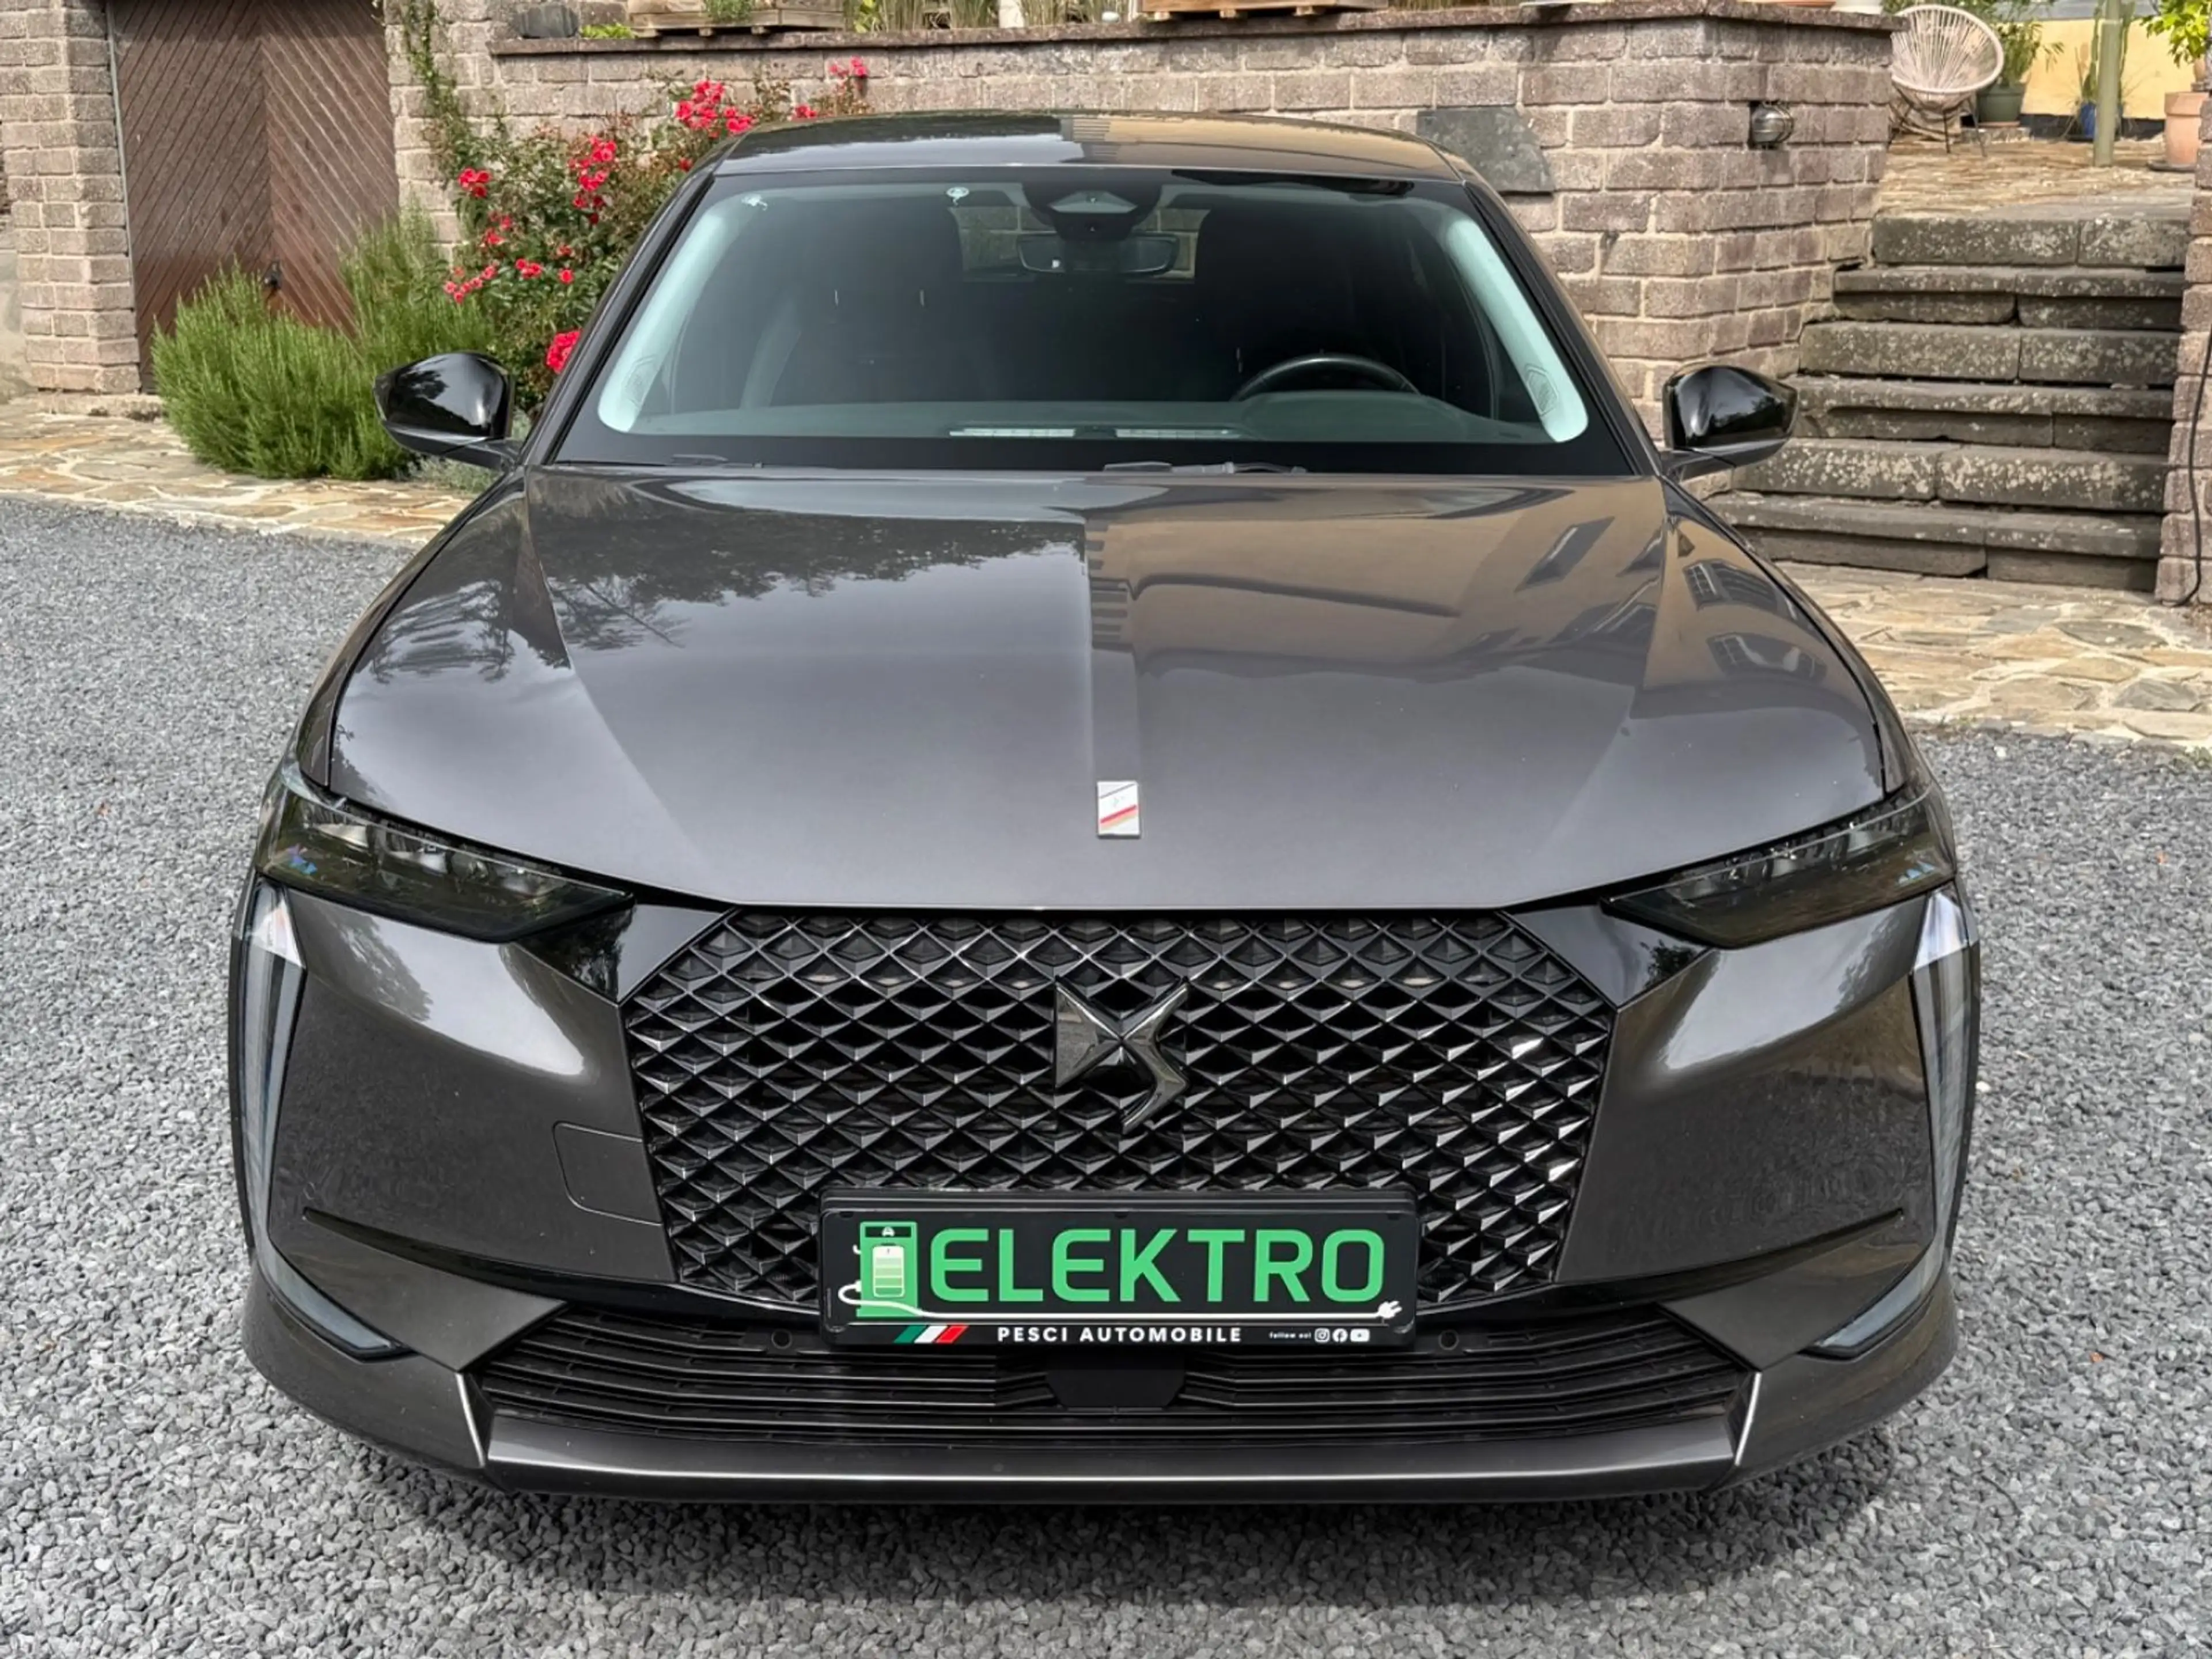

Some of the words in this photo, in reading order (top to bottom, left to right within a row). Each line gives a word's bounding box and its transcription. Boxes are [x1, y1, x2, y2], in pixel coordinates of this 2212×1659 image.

[930, 1228, 1385, 1302] ELEKTRO
[997, 1327, 1067, 1342] PESCI
[1080, 1327, 1241, 1342] AUTOMOBILE
